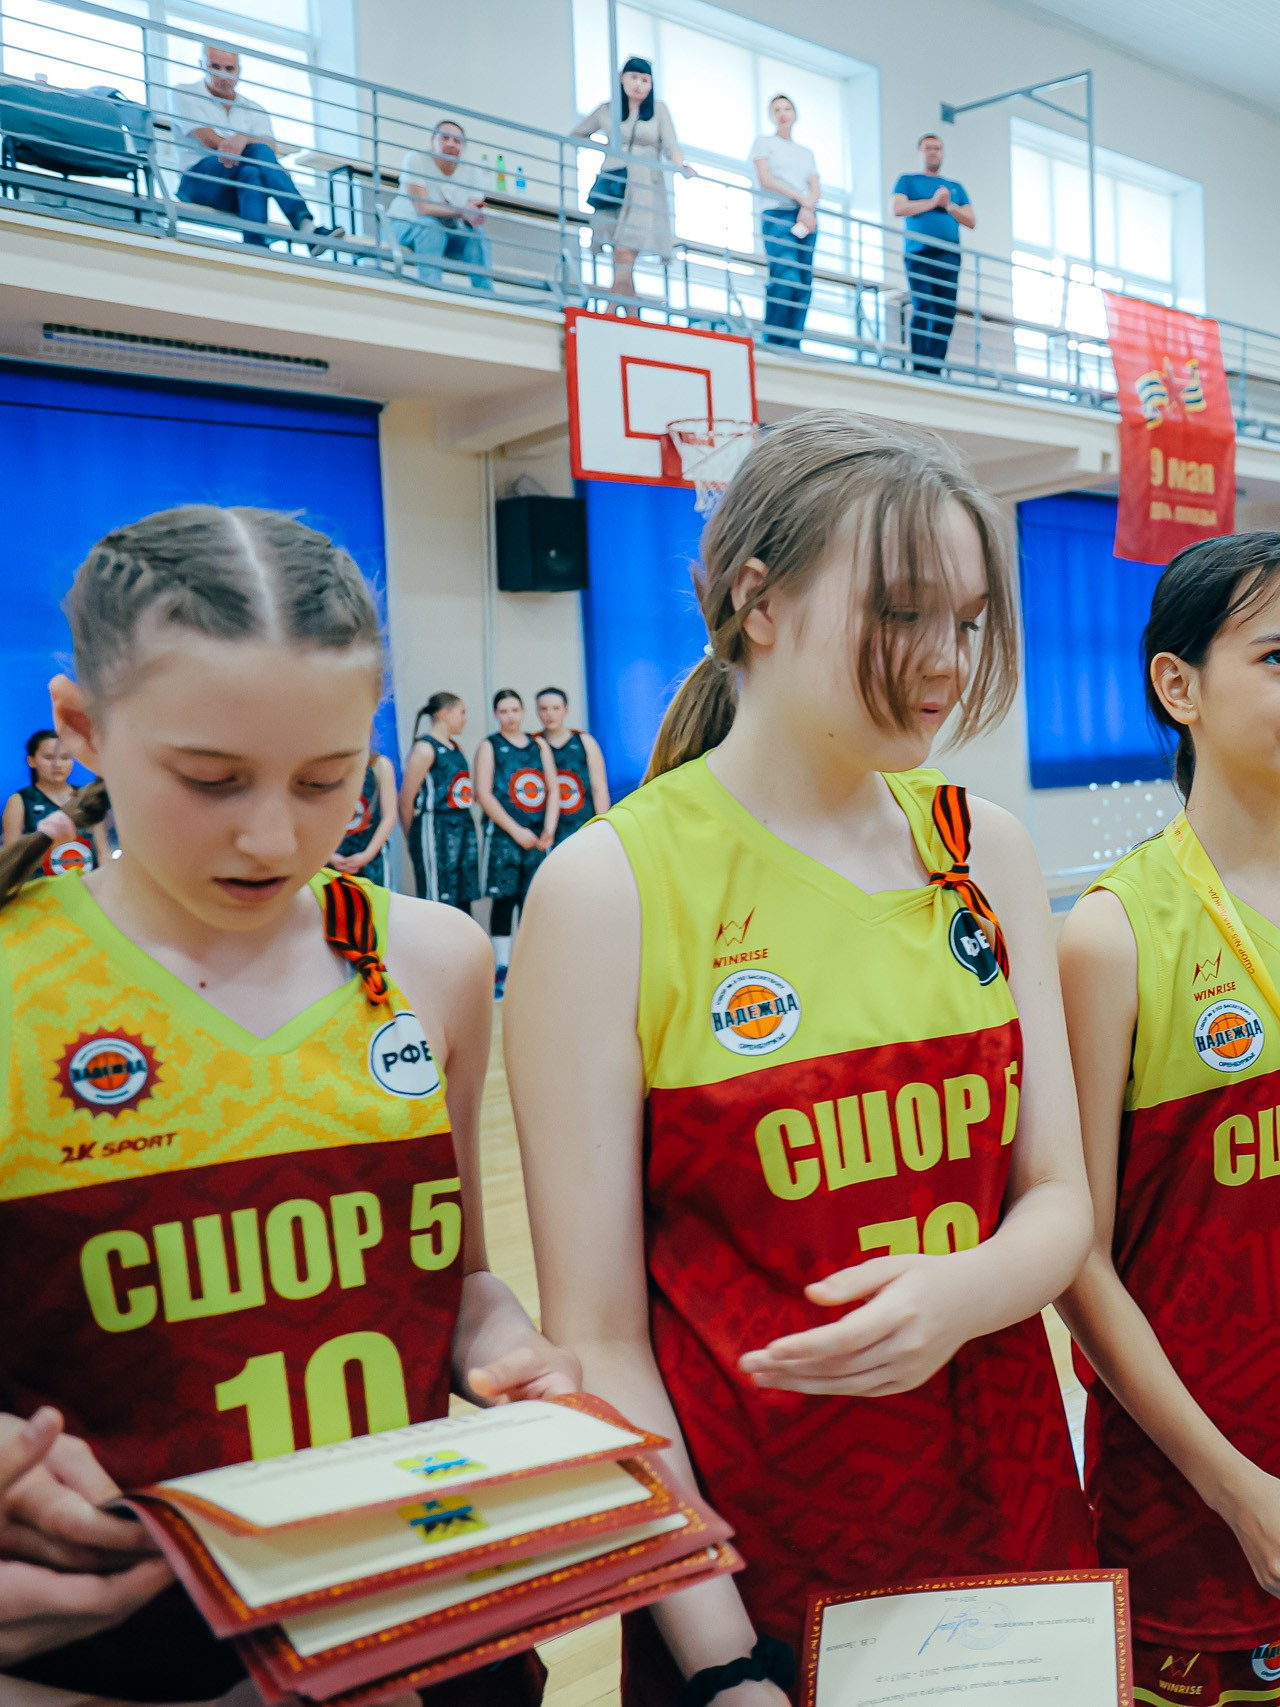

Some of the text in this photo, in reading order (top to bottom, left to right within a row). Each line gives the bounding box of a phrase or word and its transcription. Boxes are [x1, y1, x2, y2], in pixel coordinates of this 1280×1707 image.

[712, 948, 769, 969] WINRISE
[1238, 949, 1255, 976] СШОР
[1193, 981, 1236, 1002] WINRISE
[711, 992, 800, 1033] НАДЕЖДА
[1195, 1018, 1263, 1053] НАДЕЖДА
[61, 1132, 177, 1165] 2K SPORT
[754, 1073, 991, 1201] СШОР
[79, 1177, 462, 1333] СШОР 5
[215, 1330, 410, 1461] 10
[1158, 1679, 1204, 1696] WINRISE
